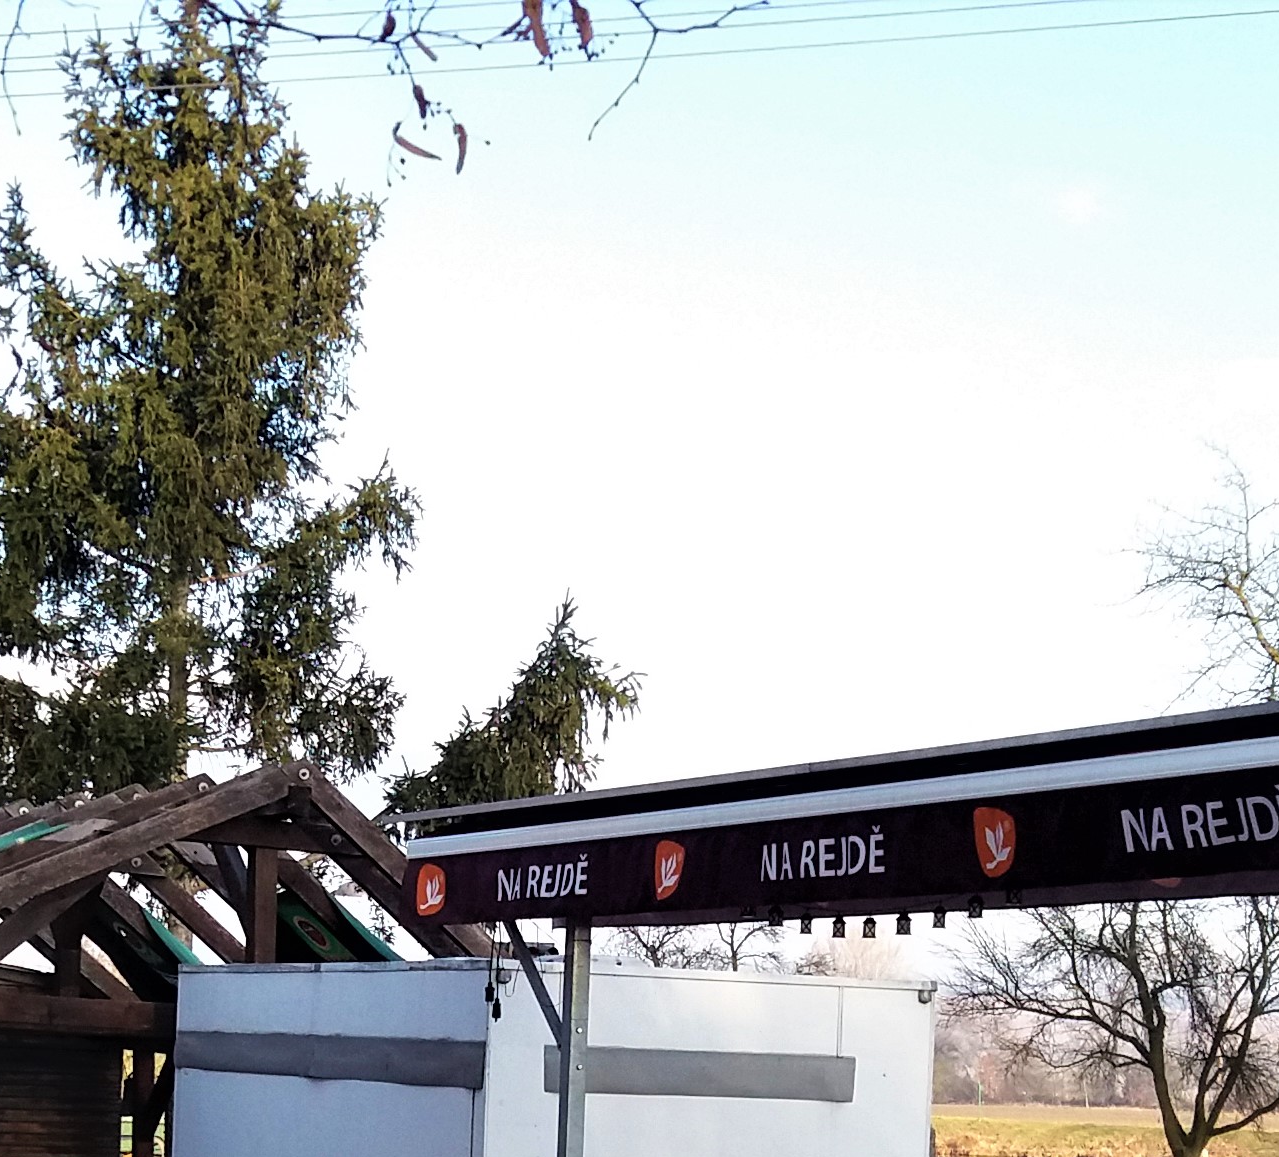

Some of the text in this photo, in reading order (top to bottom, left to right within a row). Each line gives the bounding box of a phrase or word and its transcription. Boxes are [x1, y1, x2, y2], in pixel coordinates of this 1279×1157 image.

[759, 825, 886, 882] NA REJDĚ
[1120, 806, 1175, 853] NA
[497, 852, 589, 902] NA REJDĚ
